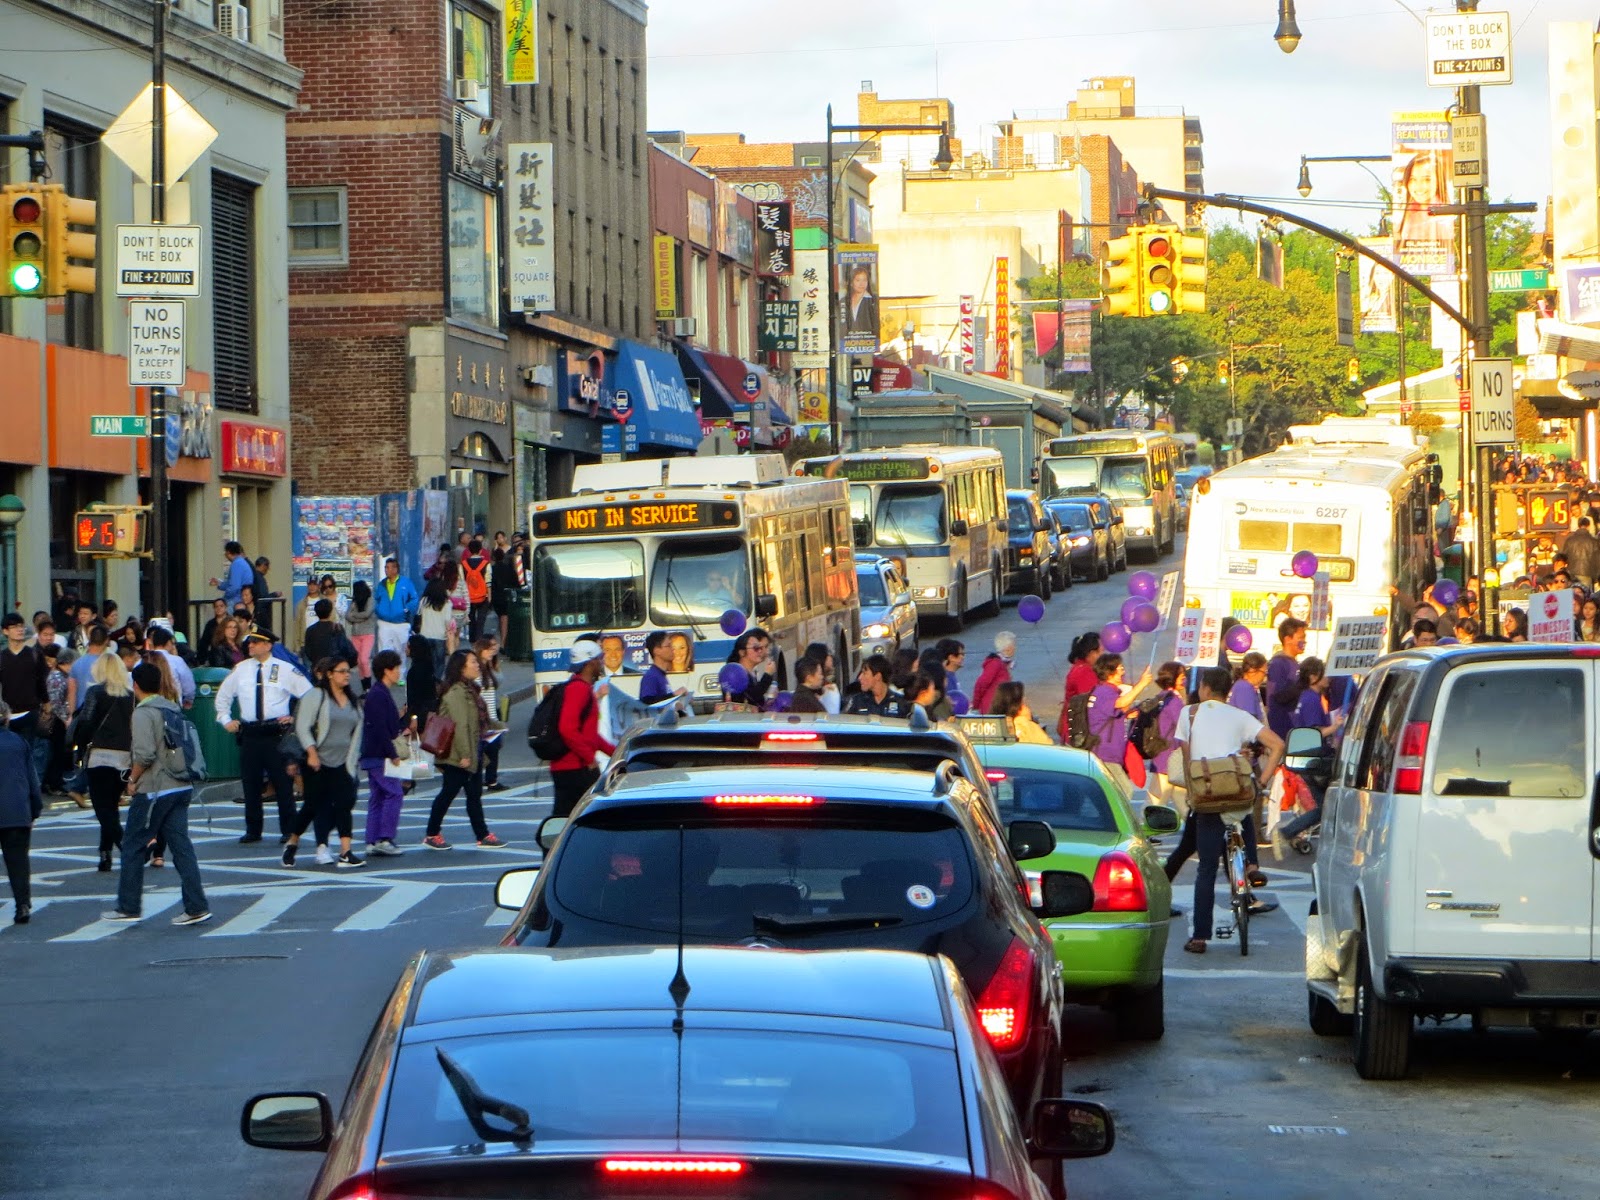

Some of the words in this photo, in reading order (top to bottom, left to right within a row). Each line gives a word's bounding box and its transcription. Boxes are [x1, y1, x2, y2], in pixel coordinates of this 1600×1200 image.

[1470, 22, 1503, 34] BLOCK
[1447, 39, 1464, 50] THE
[1471, 38, 1491, 49] BOX
[1397, 130, 1416, 139] REAL
[123, 236, 153, 248] DON'T
[160, 237, 194, 248] BLOCK
[136, 250, 154, 262] THE
[160, 251, 181, 262] BOX
[1400, 254, 1447, 264] MONROE
[514, 272, 550, 285] SQUARE
[659, 242, 670, 307] BEEPERS
[1494, 272, 1522, 289] MAIN
[1534, 271, 1543, 280] ST
[145, 308, 168, 322] NO
[766, 303, 798, 316] 프라이스
[133, 326, 181, 340] TURNS
[961, 297, 974, 366] PIZZA
[134, 344, 180, 355] 7AM-7PM
[139, 358, 174, 368] EXCEPT
[141, 370, 172, 380] BUSES
[853, 368, 872, 382] DV
[1483, 370, 1503, 398] NO
[95, 418, 122, 434] MAIN
[134, 418, 144, 427] ST
[1475, 411, 1513, 432] TURNS
[848, 470, 876, 478] MAIN
[897, 468, 918, 476] STA
[566, 510, 597, 529] NOT
[605, 507, 624, 527] IN
[631, 504, 698, 525] SERVICE
[1316, 507, 1347, 519] 6287
[1553, 500, 1568, 525] 15
[1232, 598, 1259, 609] MIKE
[1232, 609, 1269, 621] MOLLY
[1533, 619, 1570, 635] DOMESTIC
[1350, 637, 1380, 650] SEXUAL
[1335, 654, 1376, 669] VIOLENCE
[963, 722, 997, 736] AF006
